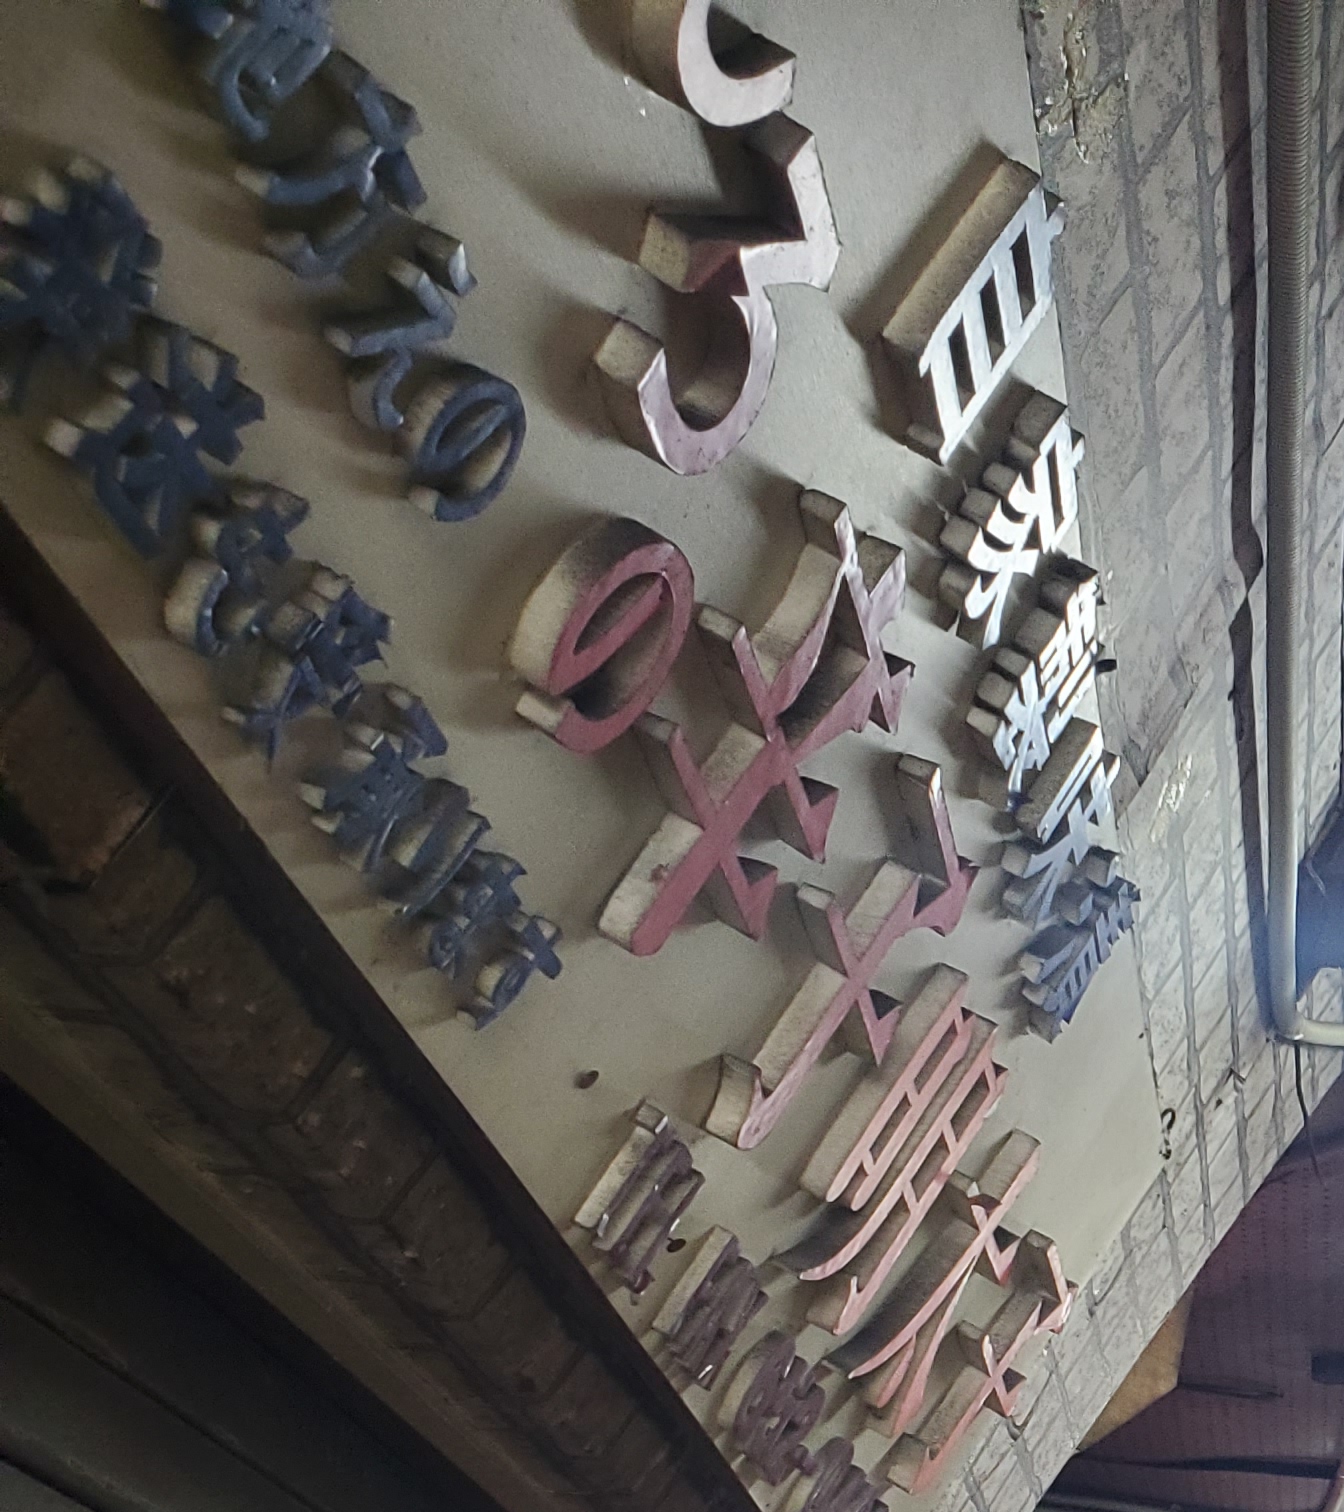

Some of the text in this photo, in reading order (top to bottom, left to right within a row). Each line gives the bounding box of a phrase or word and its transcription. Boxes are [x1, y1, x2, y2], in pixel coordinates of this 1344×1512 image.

[885, 145, 1142, 1040] 自家製味漬
